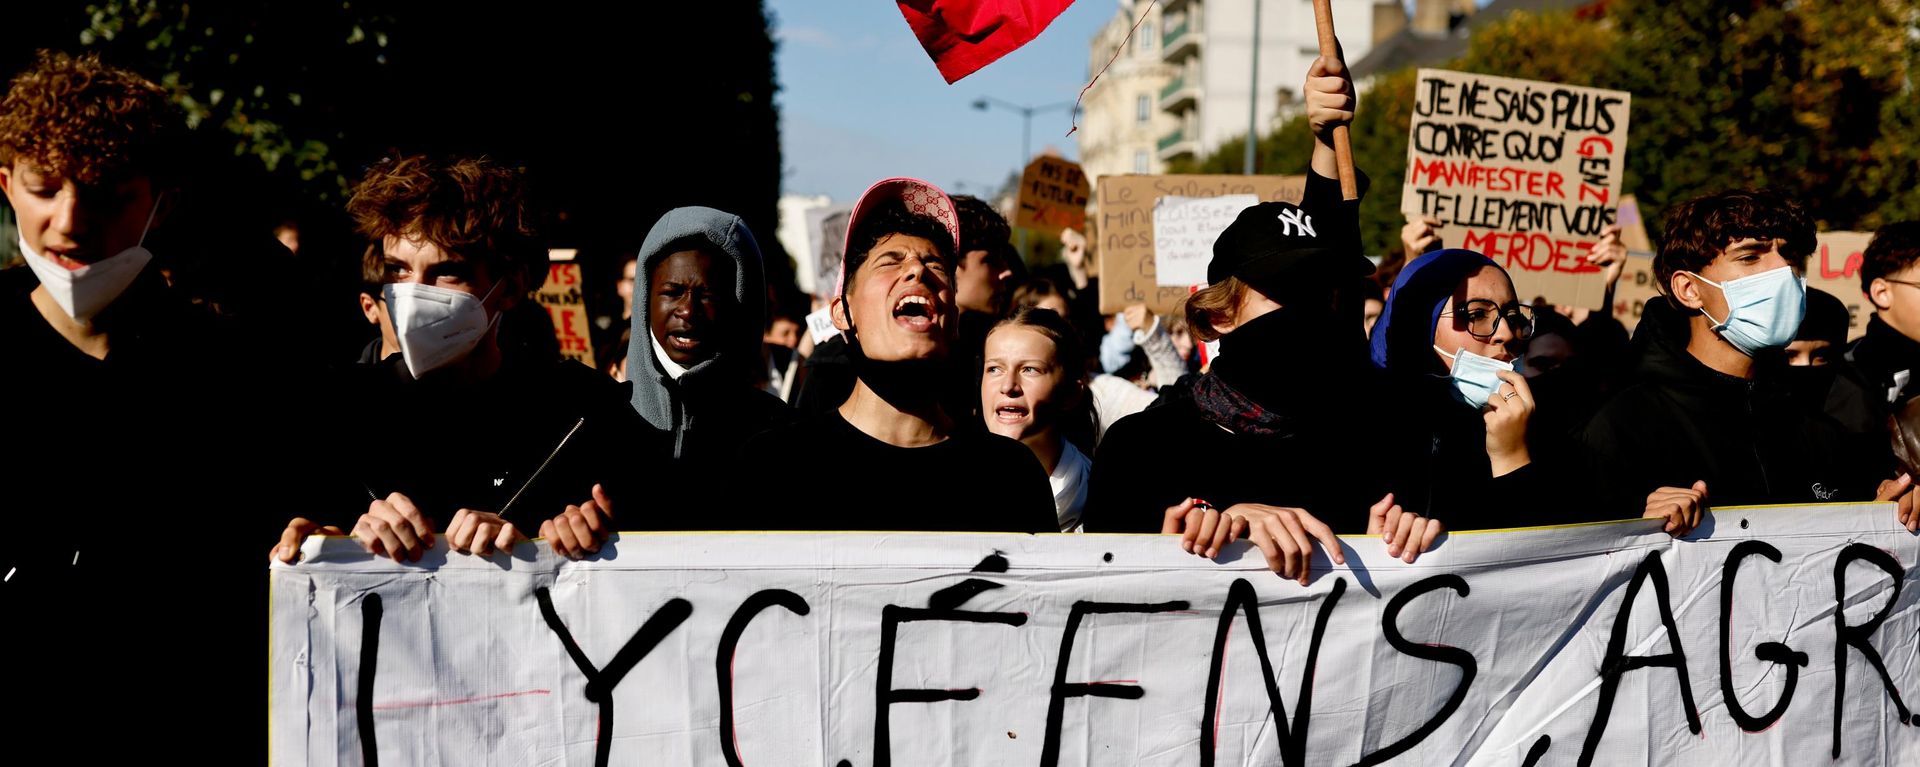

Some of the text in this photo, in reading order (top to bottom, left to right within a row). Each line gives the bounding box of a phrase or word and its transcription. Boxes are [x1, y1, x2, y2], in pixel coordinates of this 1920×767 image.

[1416, 78, 1455, 117] JE
[1458, 79, 1490, 119] NE
[1551, 89, 1623, 134] PLUS
[1415, 121, 1499, 160] CONTRE
[1576, 135, 1613, 187] GEN
[1102, 182, 1137, 205] Le
[1416, 188, 1558, 232] TELLEMENT
[1277, 207, 1318, 238] NY
[1577, 540, 1920, 767] AGR
